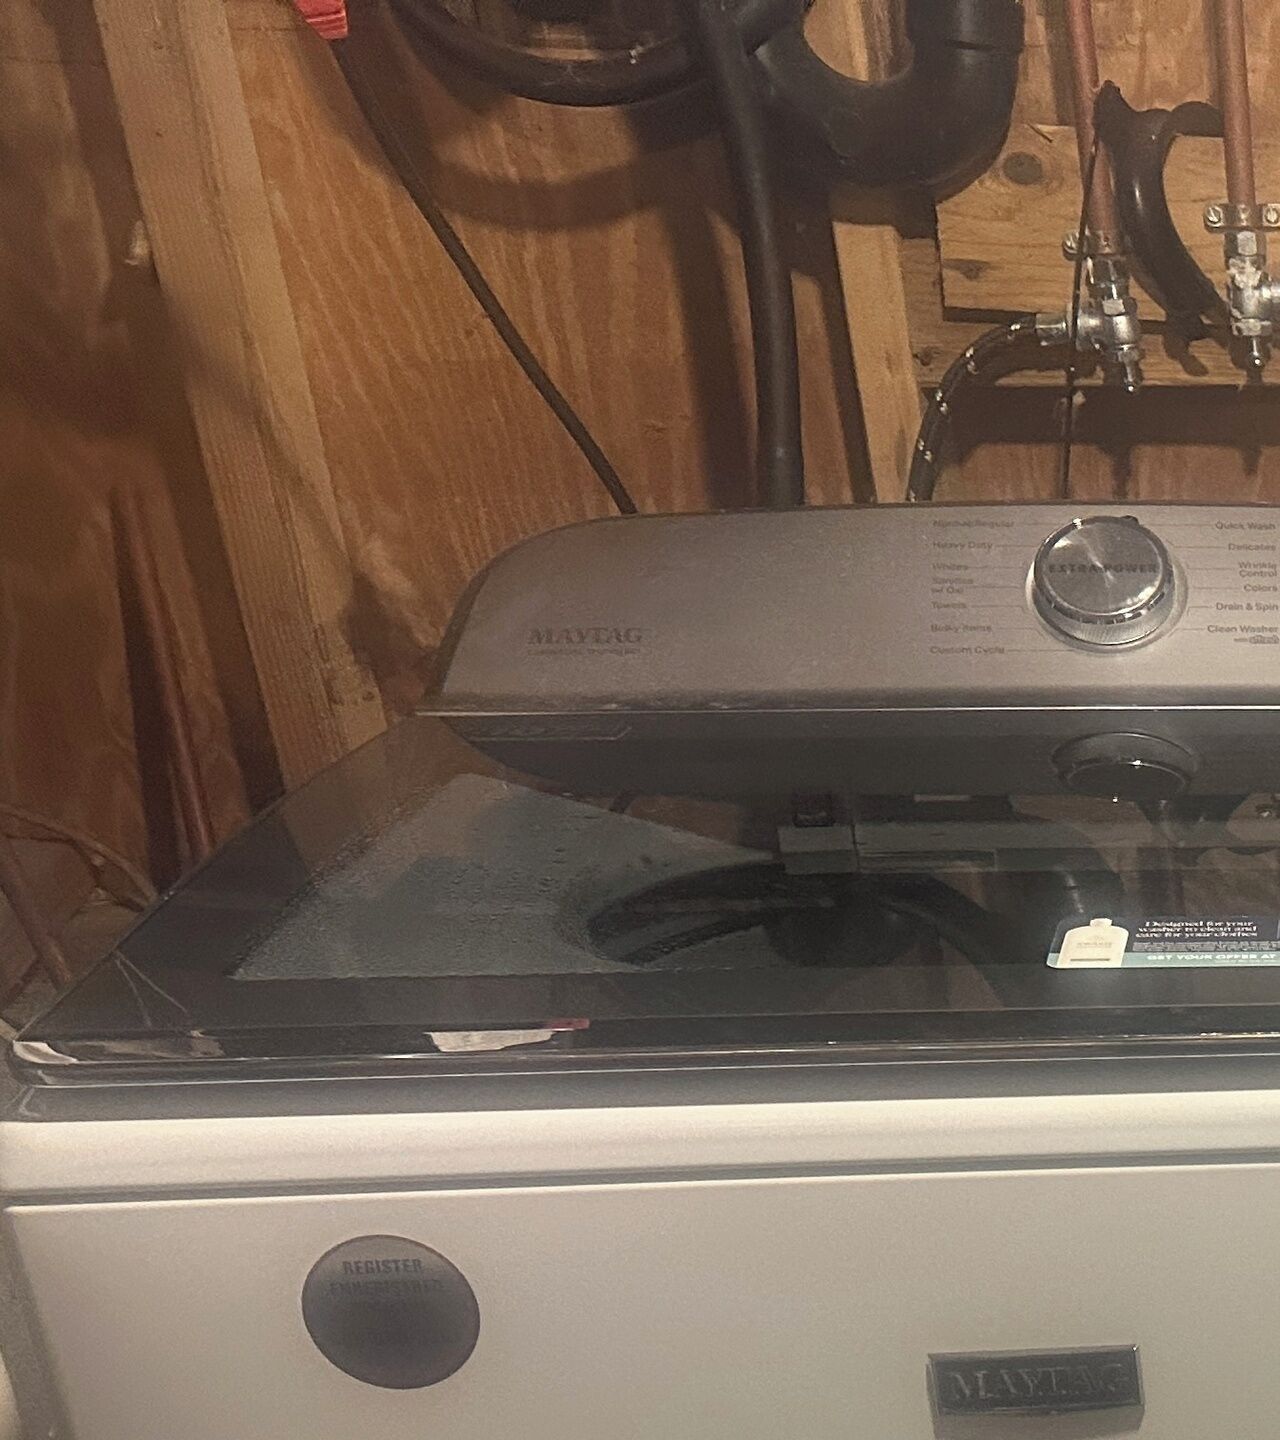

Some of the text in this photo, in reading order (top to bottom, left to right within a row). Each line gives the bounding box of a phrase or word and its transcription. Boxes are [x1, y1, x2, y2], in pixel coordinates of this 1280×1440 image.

[527, 627, 643, 644] MAYTAG
[342, 1258, 424, 1276] REGISTER
[954, 1363, 1128, 1400] MAYTAG
